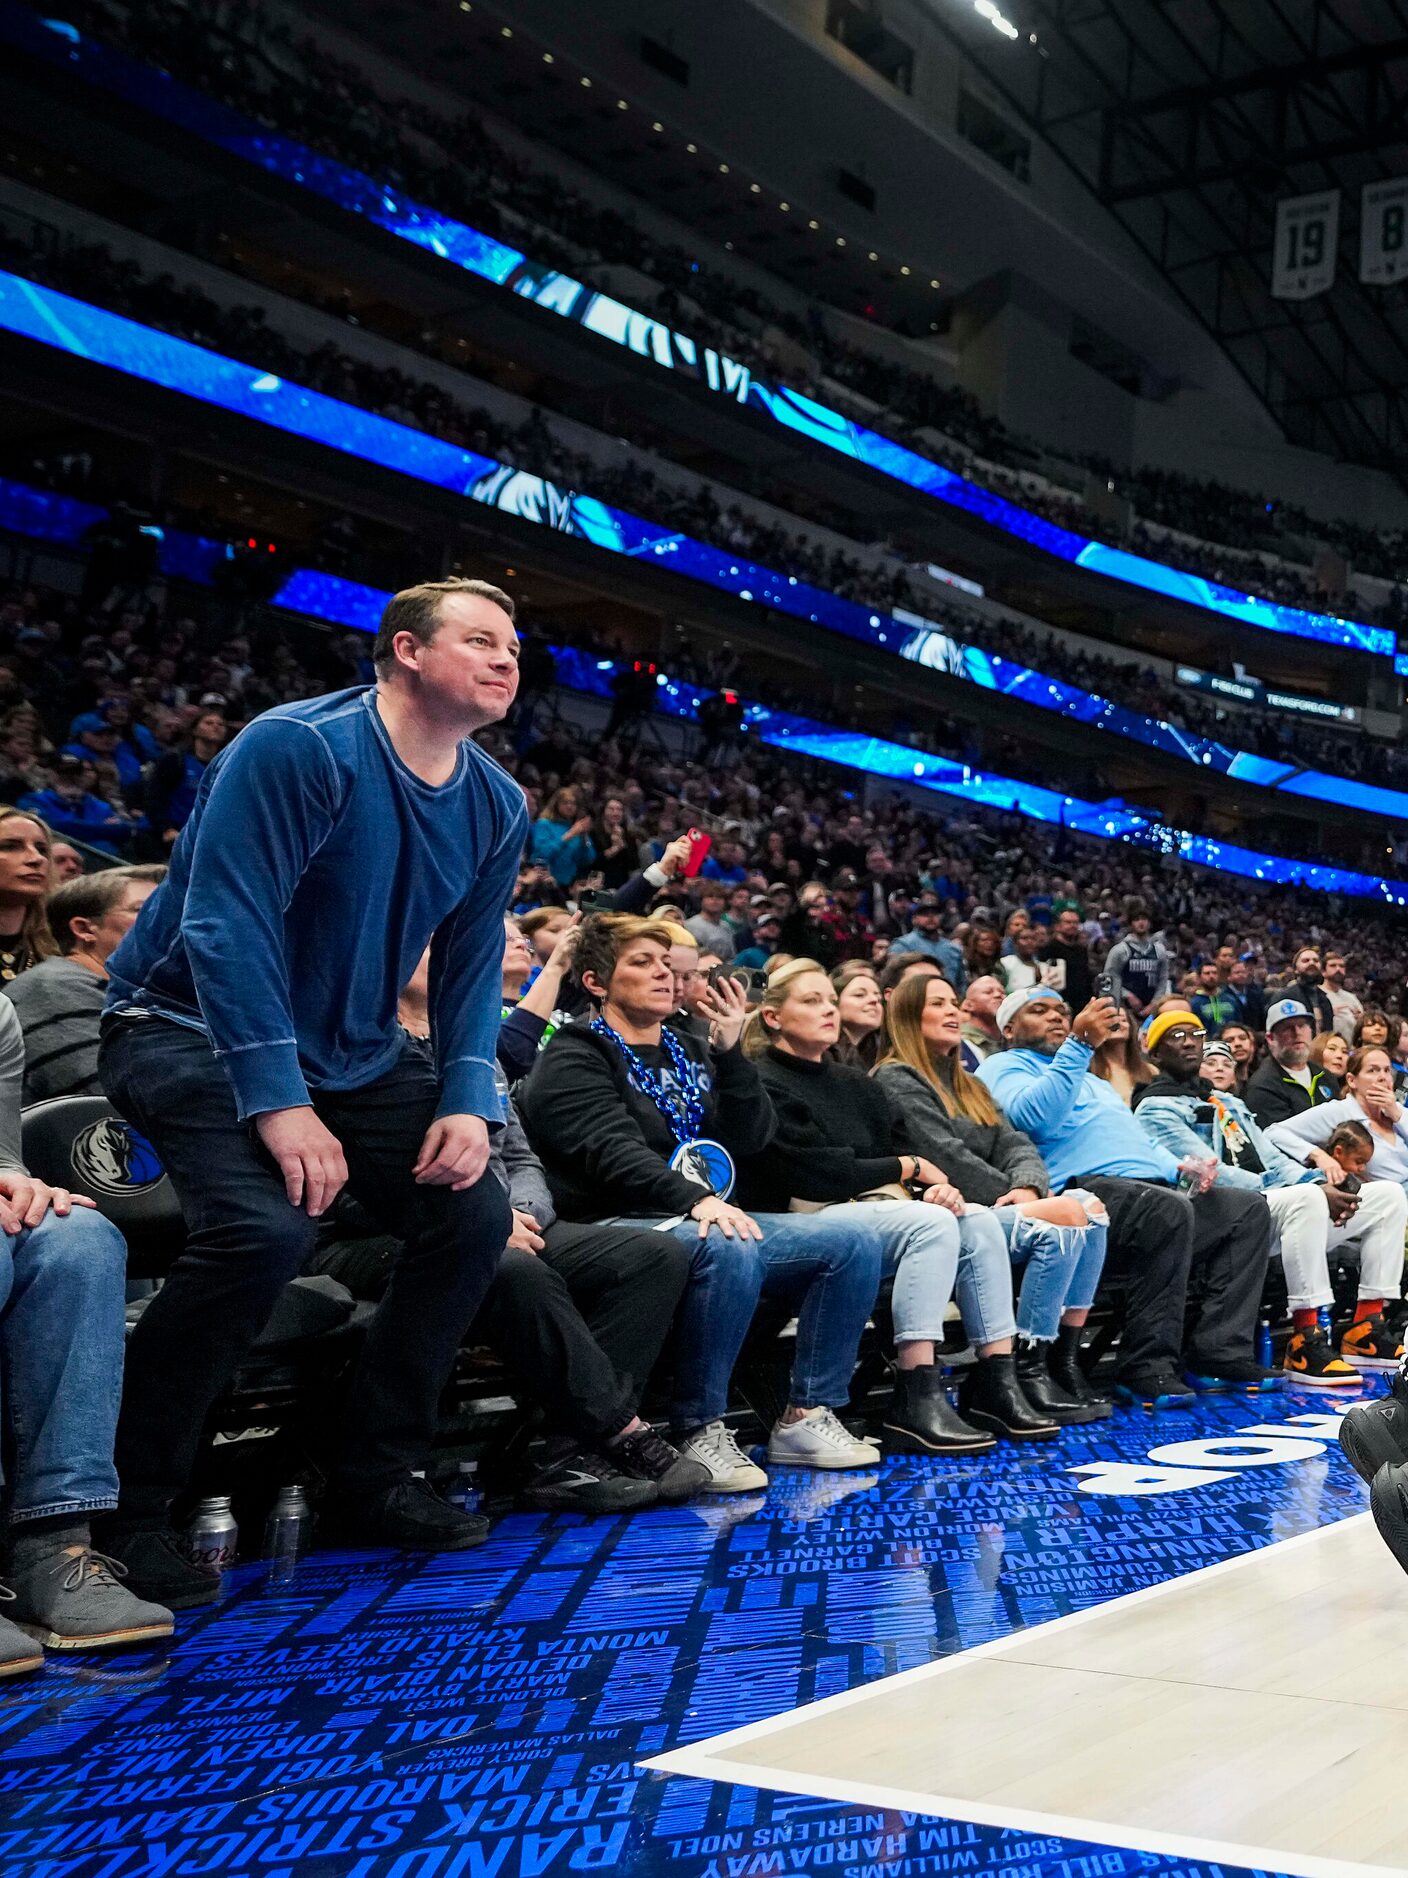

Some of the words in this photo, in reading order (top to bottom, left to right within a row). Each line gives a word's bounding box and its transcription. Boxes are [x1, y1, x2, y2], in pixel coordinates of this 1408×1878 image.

[1383, 206, 1404, 252] 8
[1287, 221, 1325, 269] 19
[831, 1476, 1079, 1505] NOWITZK
[934, 1493, 1075, 1510] DESHAWN
[781, 1511, 938, 1534] CARTER
[951, 1503, 1070, 1523] VINCE
[1037, 1513, 1142, 1527] WILLIAMS
[793, 1530, 884, 1545] WILEY
[892, 1520, 1006, 1539] MORLON
[1035, 1516, 1246, 1546] HARPER
[739, 1543, 874, 1562] GARNETT
[878, 1547, 981, 1567] SCOTT
[882, 1539, 942, 1552] BILL
[726, 1556, 868, 1578] BROOKS
[1000, 1561, 1163, 1585] CUMMINGS
[1015, 1577, 1123, 1595] JAMISON
[340, 1628, 413, 1641] FISHER
[377, 1627, 526, 1653] KHALID
[416, 1622, 480, 1635] DEREK
[204, 1640, 372, 1670] REEVES
[537, 1630, 670, 1656] MONTA
[338, 1655, 397, 1668] ERIC
[409, 1643, 524, 1668] ELLIS
[187, 1660, 336, 1683] MONTROSS
[446, 1654, 592, 1682] DEJUAN
[314, 1668, 440, 1695] BLAIR
[467, 1672, 572, 1693] MARTY
[176, 1686, 295, 1714] MFFL
[342, 1683, 464, 1706] BYRNES
[398, 1697, 466, 1712] WEST
[470, 1687, 567, 1704] DELONTE
[181, 1710, 277, 1730] DENNIS
[197, 1720, 300, 1744] EDDIE
[385, 1714, 479, 1744] DAL
[81, 1732, 200, 1758] JONES
[190, 1728, 364, 1768] LOREN
[425, 1739, 539, 1759] MAVERICKS
[546, 1729, 620, 1745] DALLAS
[395, 1755, 484, 1775] BREWER
[487, 1747, 554, 1765] COREY
[258, 1750, 384, 1787] YOGI
[585, 1761, 649, 1782] AVS
[8, 1766, 257, 1820] FERRELL
[243, 1763, 531, 1825] MARQUIS
[422, 1781, 639, 1840] ERICK
[752, 1813, 884, 1847] NERLENS
[918, 1823, 982, 1851] TIM
[665, 1832, 744, 1859] NOEL
[701, 1833, 907, 1878] HARDAWAY
[987, 1837, 1064, 1863] SCOTT
[843, 1849, 979, 1878] WILLIAMS
[1051, 1851, 1126, 1878] BILL
